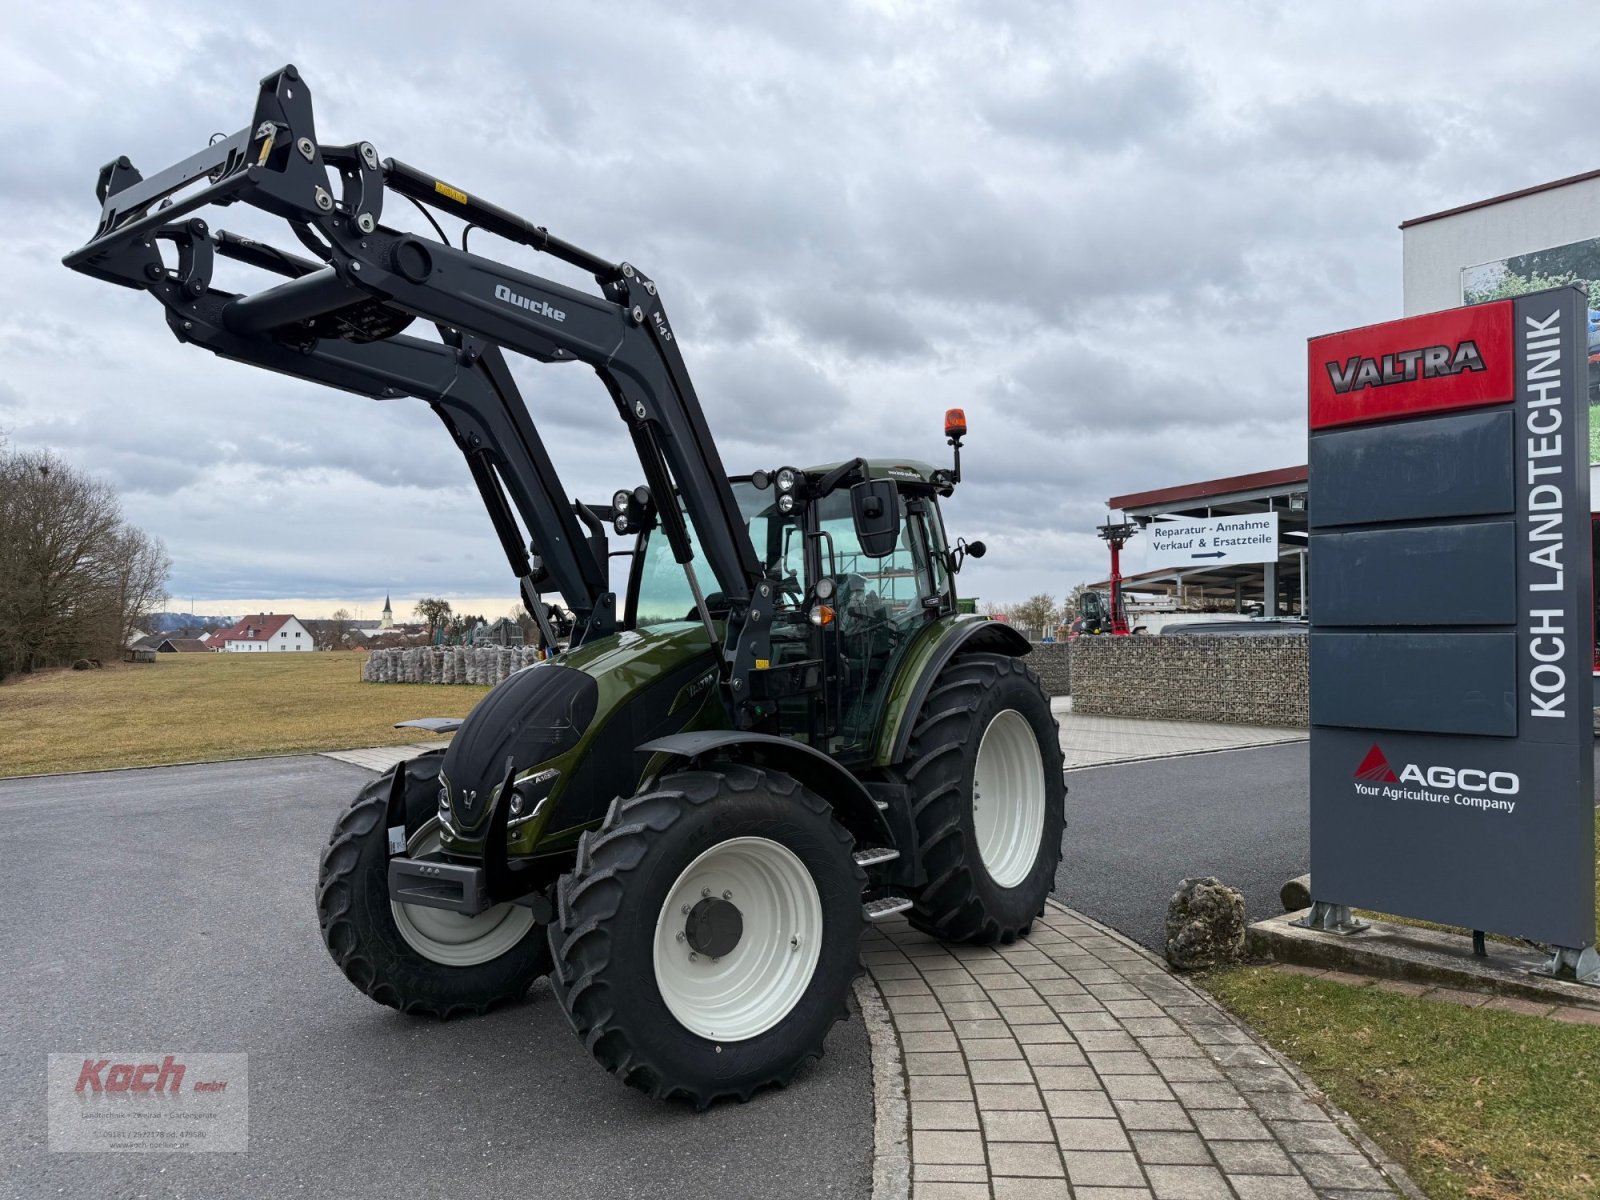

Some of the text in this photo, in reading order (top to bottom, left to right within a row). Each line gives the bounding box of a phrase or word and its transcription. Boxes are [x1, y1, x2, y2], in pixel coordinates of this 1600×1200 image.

[494, 284, 566, 322] Quicke
[1325, 340, 1486, 394] VALTRA
[1155, 525, 1206, 538] Reparatur
[1216, 520, 1270, 532] Annahme
[1526, 309, 1566, 719] KOCH LANDTECHNIK
[1153, 534, 1272, 551] Verkauf & Ersatzteile
[1399, 763, 1520, 795] AGCO
[1354, 783, 1516, 813] Your Agriculture Company
